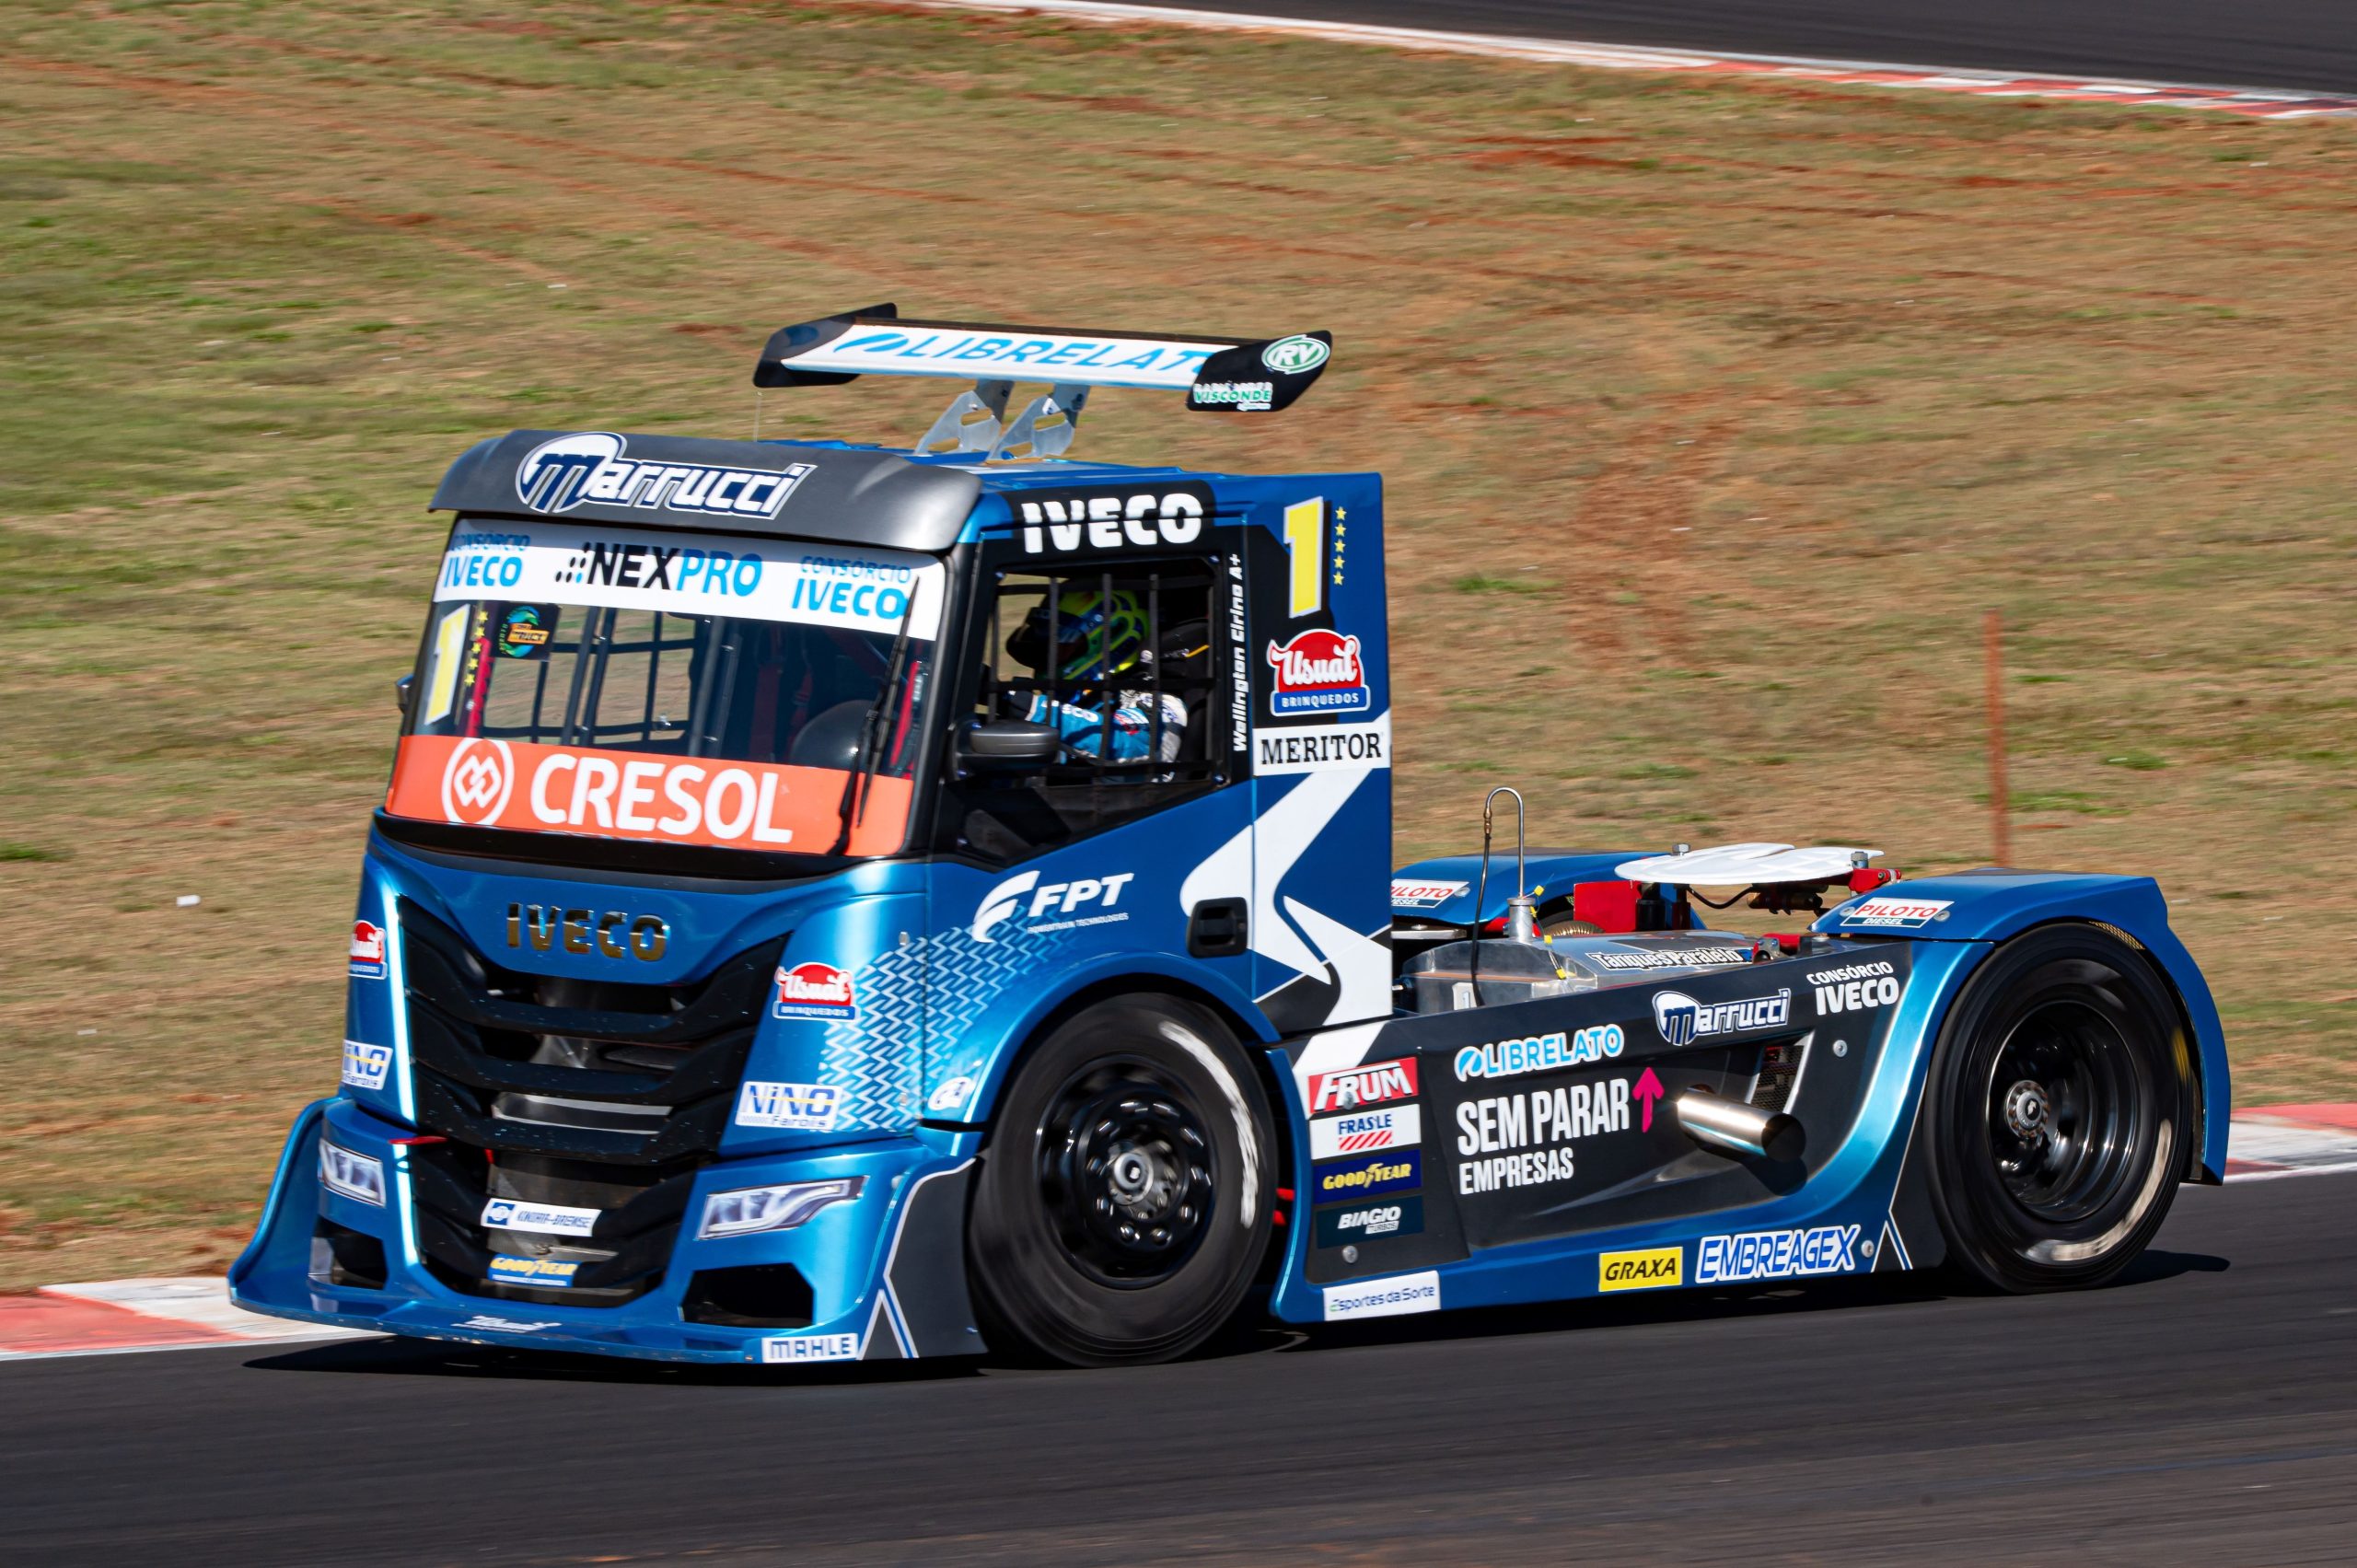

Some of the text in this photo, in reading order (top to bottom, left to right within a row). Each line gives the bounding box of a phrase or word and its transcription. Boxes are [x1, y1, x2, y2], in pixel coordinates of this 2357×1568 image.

[895, 334, 1214, 375] LIBRELAT
[1272, 343, 1318, 366] RV
[1194, 389, 1271, 402] VISCONDE
[517, 440, 817, 519] Marrucci
[1023, 494, 1203, 554] IVECO
[444, 555, 523, 587] IVECO
[1228, 553, 1243, 581] A+
[1283, 495, 1325, 619] 1
[791, 577, 906, 620] IVECO
[1229, 584, 1245, 643] Cirino
[424, 603, 471, 725] 1
[1270, 637, 1359, 686] Usual
[1281, 691, 1360, 708] BRINQUEDOS
[1260, 732, 1382, 765] MERITOR
[529, 753, 794, 844] CRESOL
[1027, 872, 1135, 918] FPT
[1391, 898, 1420, 906] IESEL
[1854, 904, 1939, 918] PILOTO
[506, 901, 672, 962] IVECO
[1862, 917, 1904, 925] DIESEL
[777, 971, 850, 1003] Usual
[1805, 961, 1894, 985] CONSÓRCIO
[1815, 976, 1899, 1016] IVECO
[1655, 991, 1790, 1045] Marrucci
[1483, 1026, 1623, 1074] LIBRELATO
[1314, 1062, 1413, 1111] FRUM
[1456, 1077, 1631, 1156] SEM PARAR
[1322, 1162, 1412, 1190] GOODYEAR
[1458, 1147, 1574, 1196] EMPRESAS
[1338, 1206, 1402, 1230] BIAGIO
[1605, 1257, 1677, 1282] GRAXA
[1699, 1227, 1859, 1280] EMBREAGEX
[1329, 1285, 1435, 1312] Esportes da Sorte
[770, 1336, 852, 1359] MAHLE
